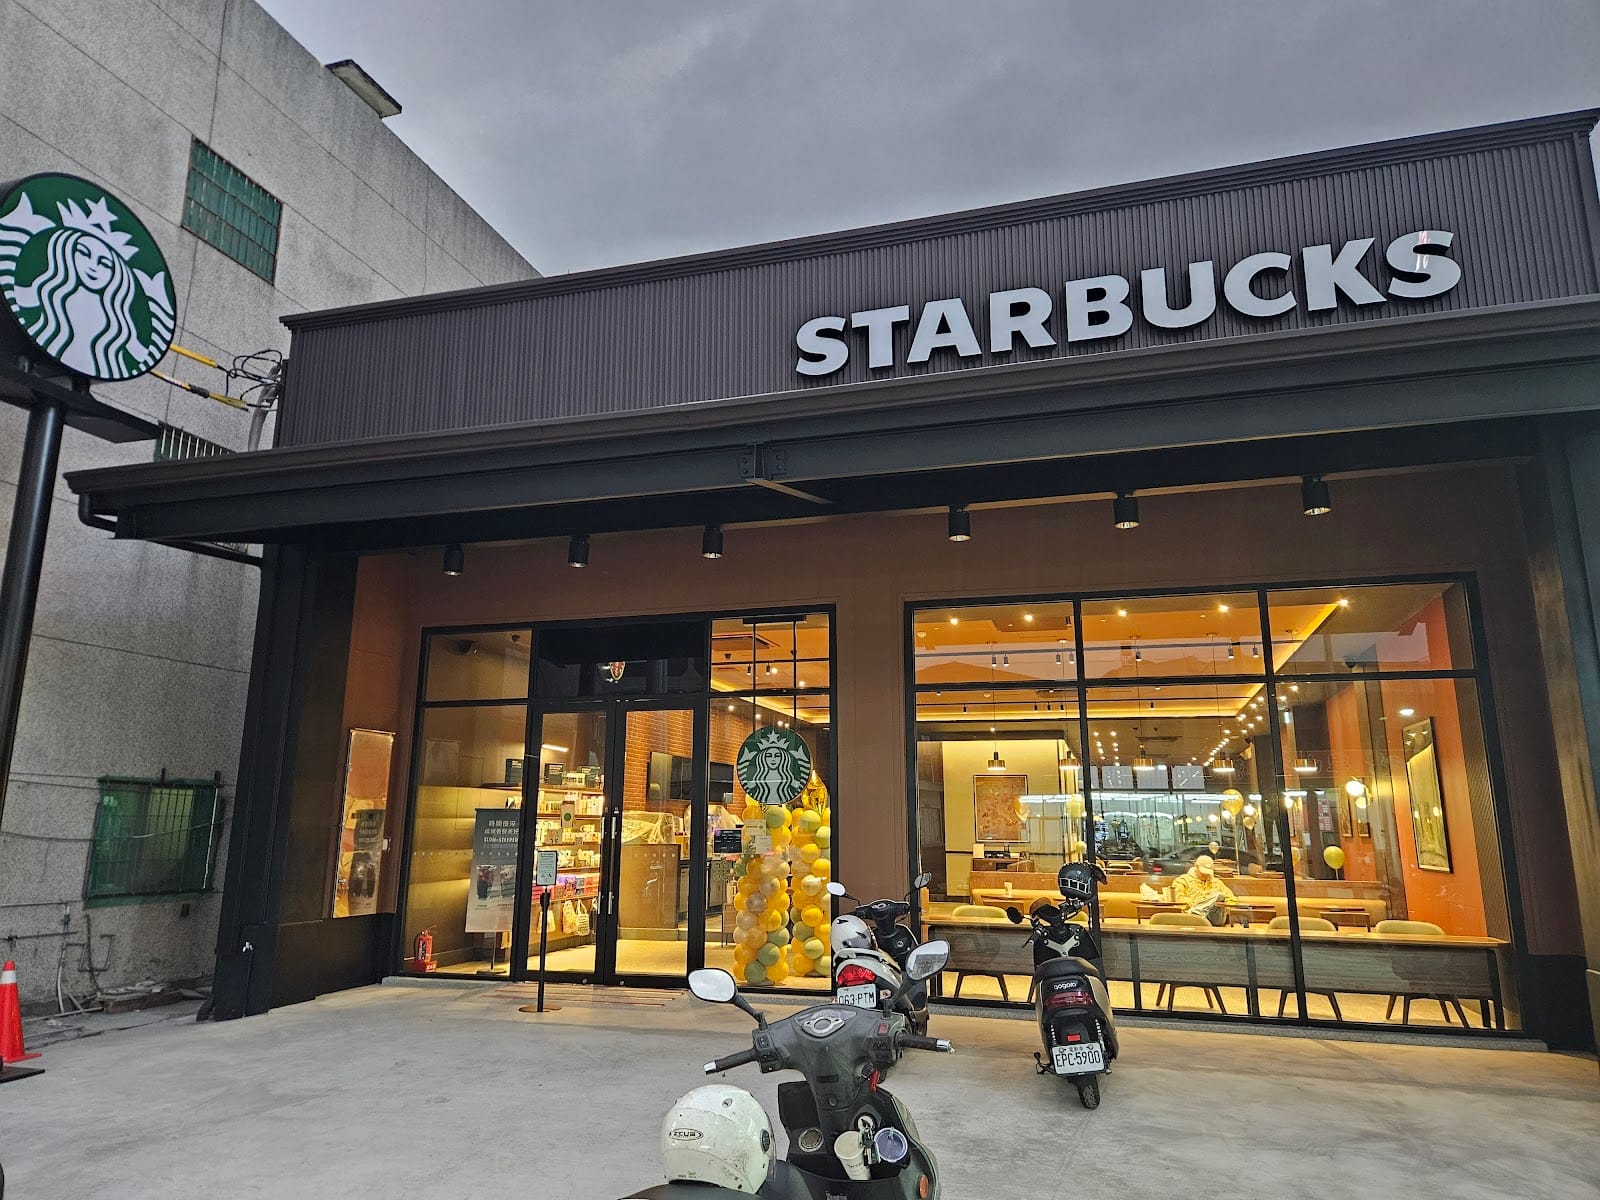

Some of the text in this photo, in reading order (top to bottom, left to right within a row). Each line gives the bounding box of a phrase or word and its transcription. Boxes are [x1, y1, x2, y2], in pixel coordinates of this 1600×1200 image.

[795, 229, 1463, 377] STARBUCKS
[1053, 981, 1077, 990] gogoro
[1055, 1050, 1101, 1068] EPC-5900
